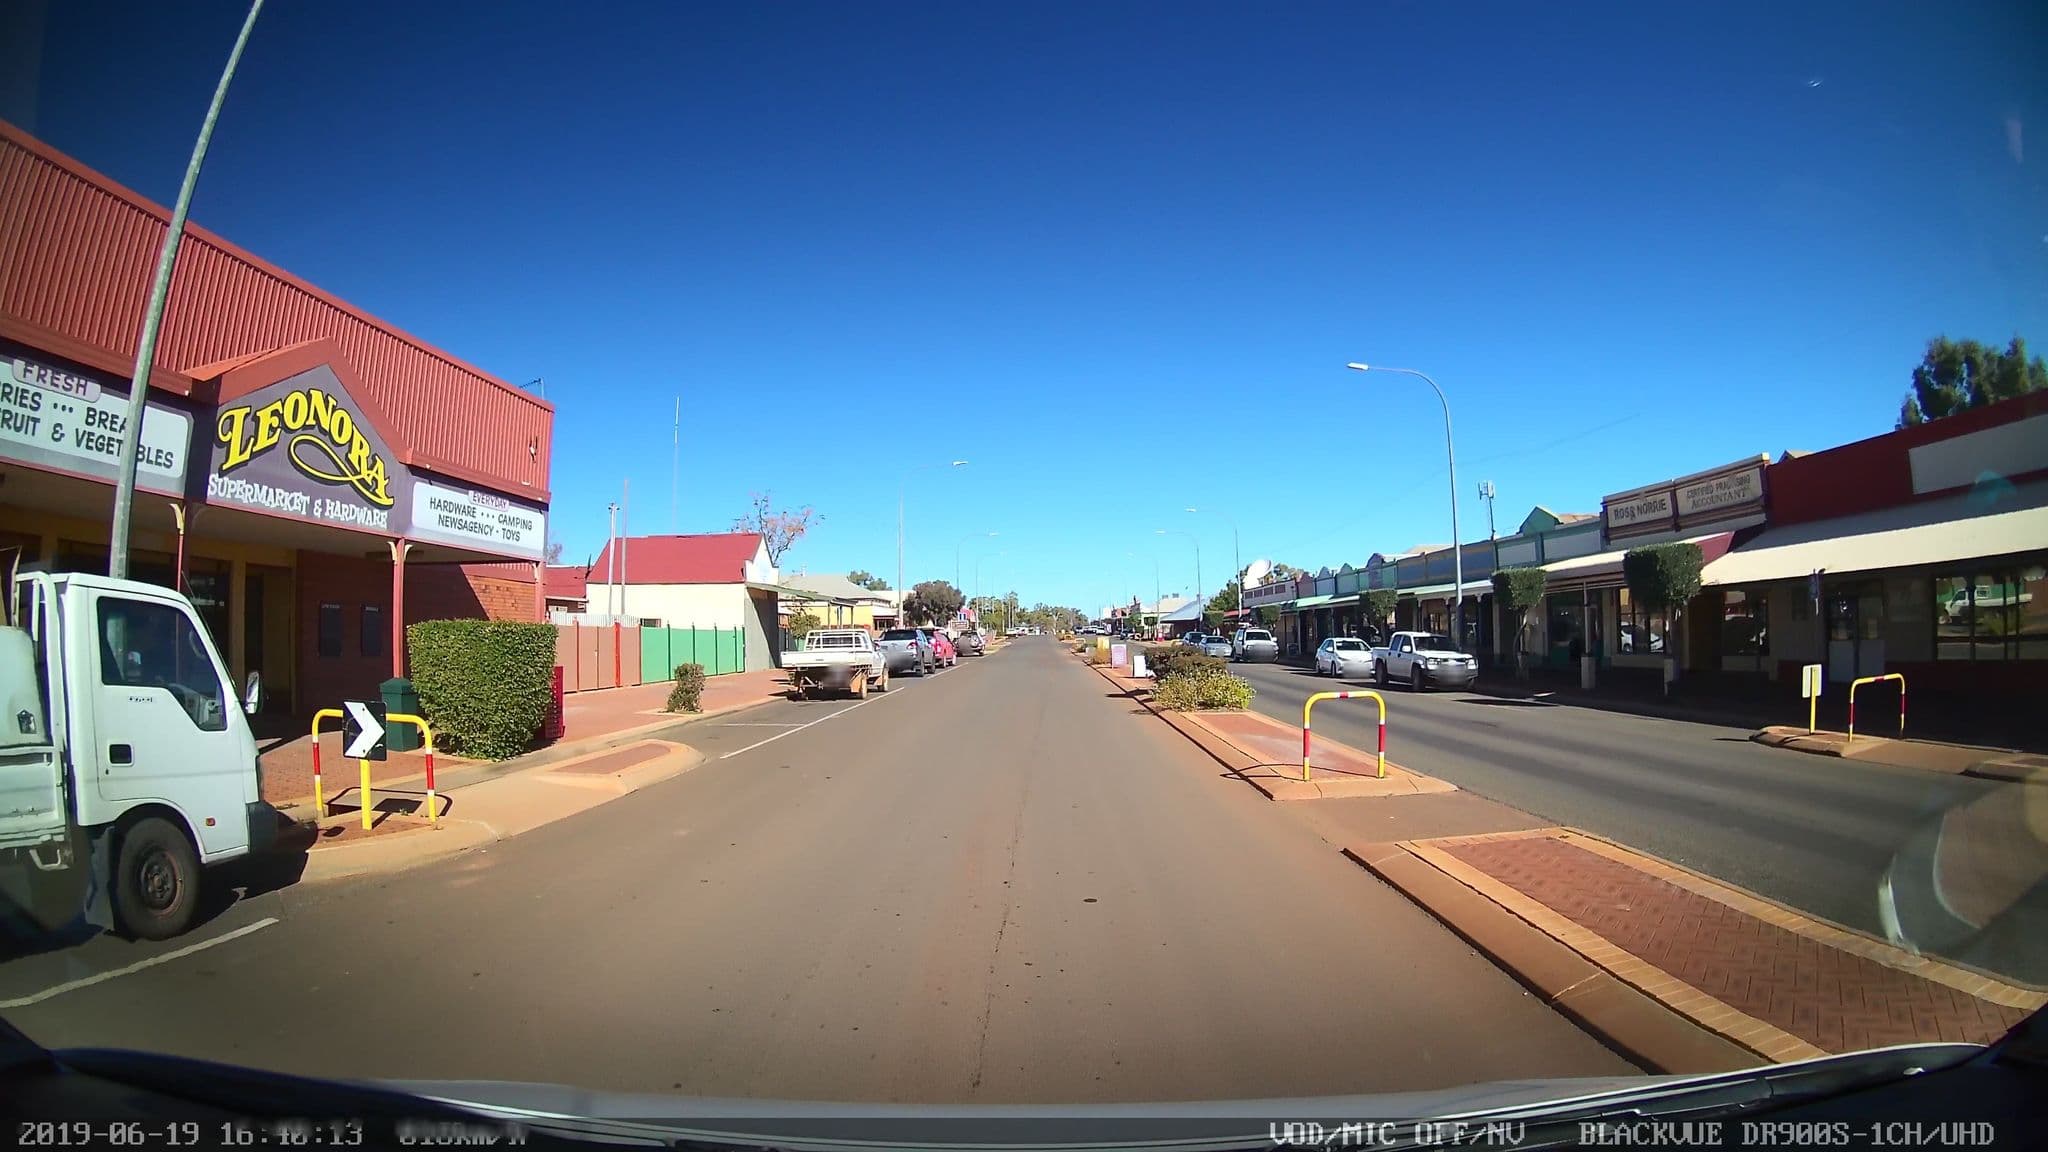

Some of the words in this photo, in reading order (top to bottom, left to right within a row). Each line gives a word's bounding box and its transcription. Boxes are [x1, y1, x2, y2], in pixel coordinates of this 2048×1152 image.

[22, 361, 88, 396] FRESH
[0, 381, 42, 412] RIES
[0, 408, 41, 436] RUIT
[51, 422, 65, 442] &
[75, 428, 174, 469] VEGETBLES
[217, 388, 395, 507] LEONORA
[207, 473, 310, 515] SUPERMARKET
[313, 499, 323, 518] &
[324, 498, 388, 530] HARDWARE
[429, 497, 477, 519] HARDWARE
[497, 513, 533, 531] CAMPING
[472, 492, 508, 510] EVERYDAY
[1636, 498, 1667, 517] NORRIE
[438, 514, 494, 537] NEWSAGENCY
[502, 528, 521, 542] TOYS
